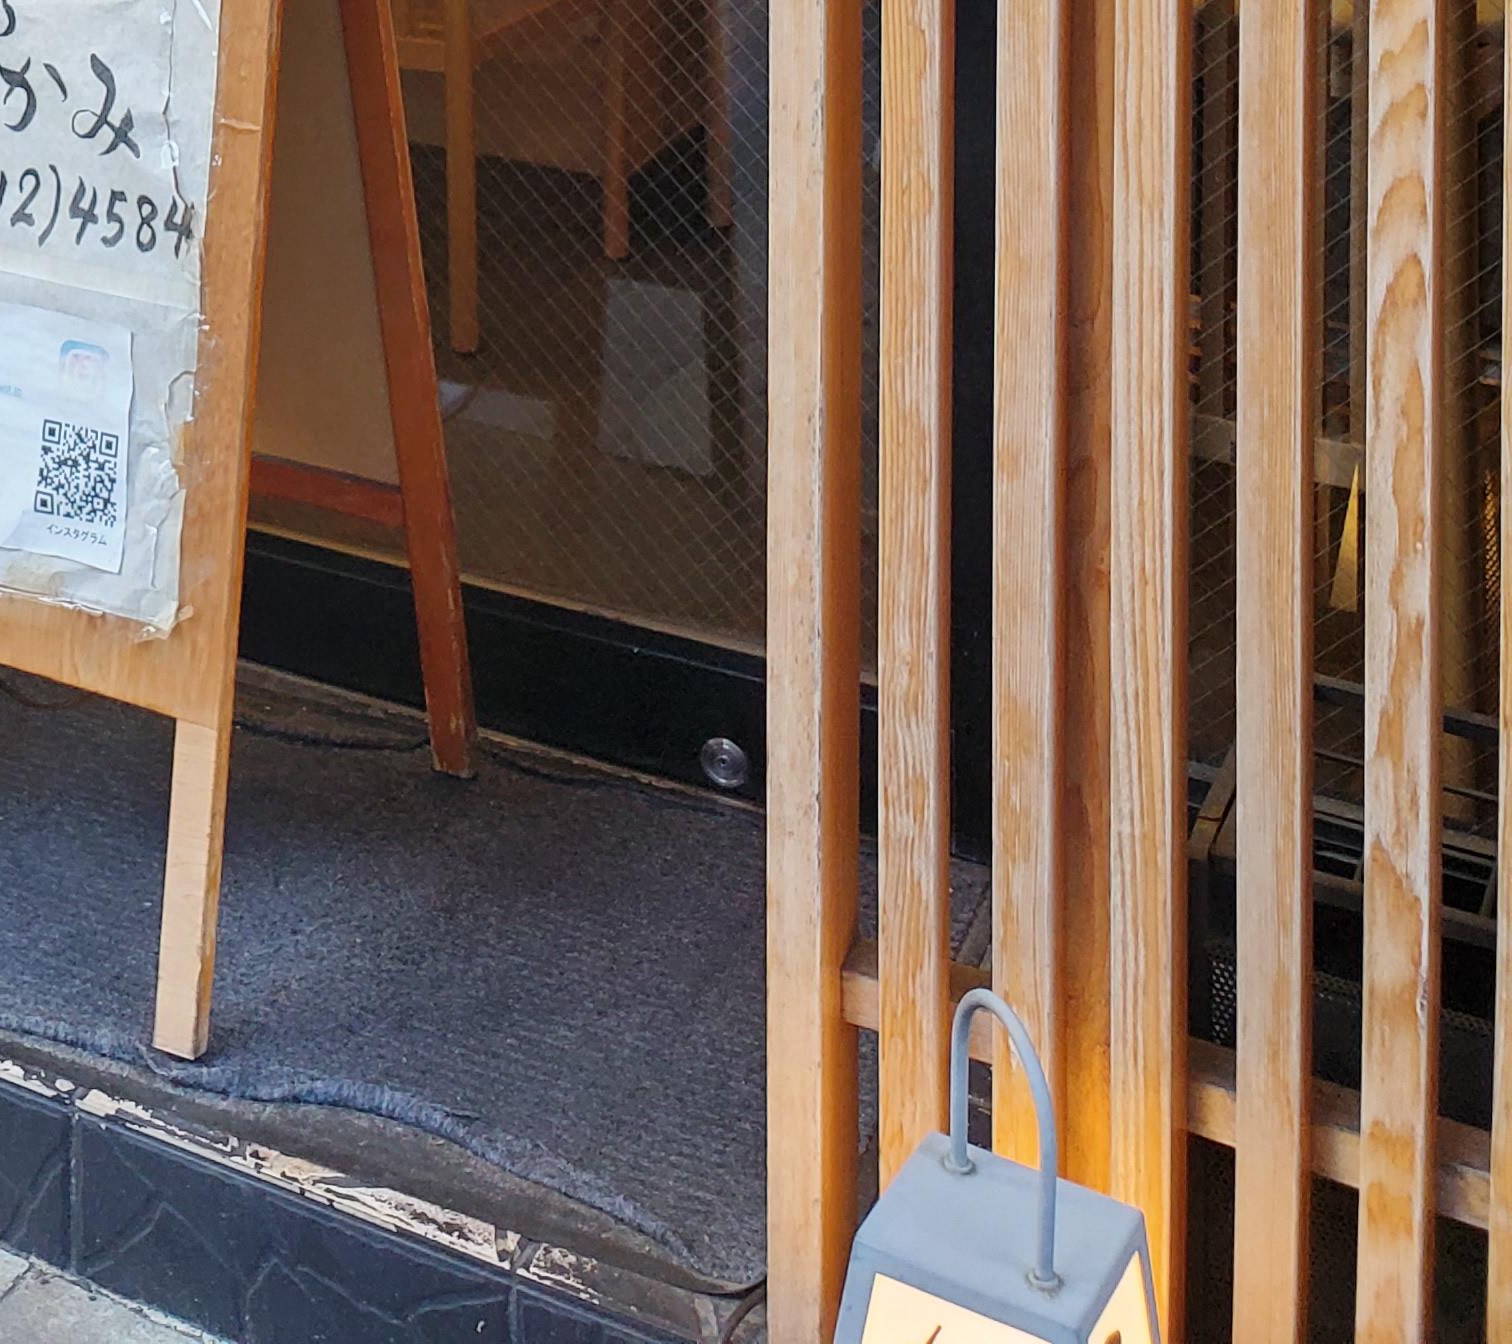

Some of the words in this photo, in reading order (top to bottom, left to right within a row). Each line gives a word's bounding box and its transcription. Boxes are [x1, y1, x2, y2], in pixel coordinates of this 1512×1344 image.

[46, 523, 108, 547] インスタグラム
